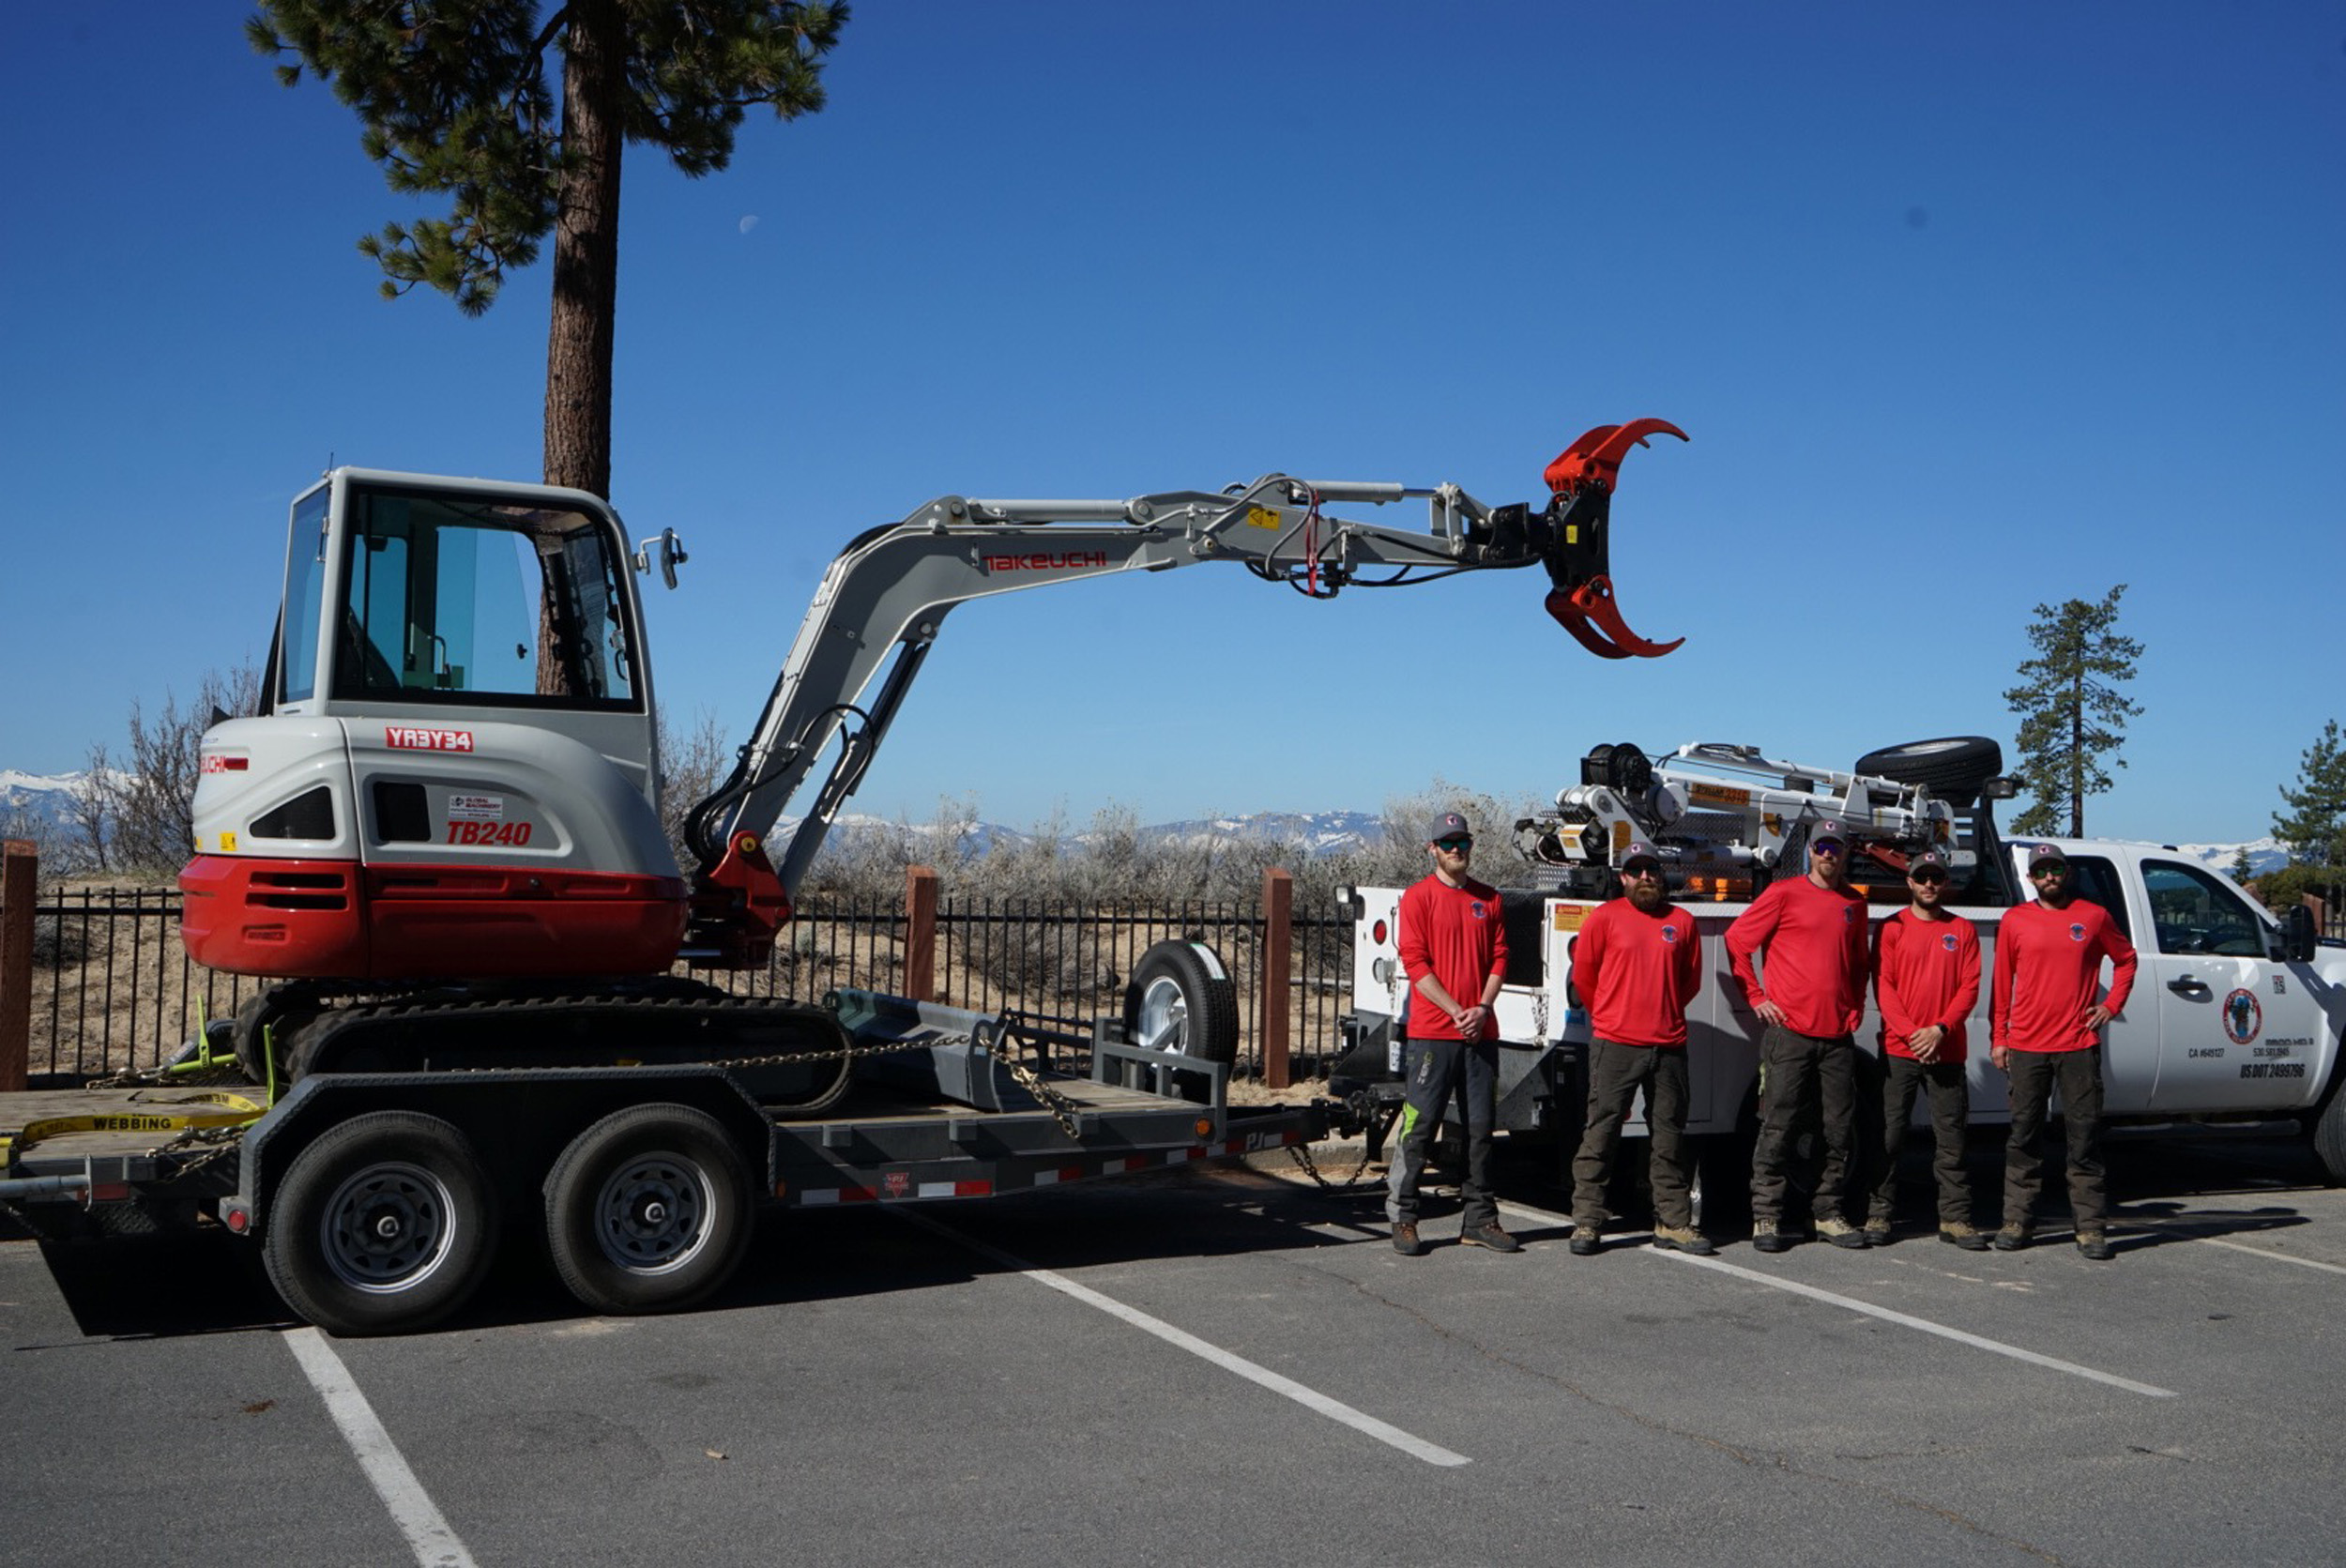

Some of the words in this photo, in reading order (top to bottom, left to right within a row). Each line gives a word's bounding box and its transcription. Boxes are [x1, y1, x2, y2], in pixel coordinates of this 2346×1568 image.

[982, 551, 1106, 571] TAKEUCHI
[447, 821, 532, 846] TB240
[2188, 1047, 2199, 1058] CA
[2240, 1063, 2252, 1079] US
[2252, 1063, 2269, 1078] DOT
[94, 1118, 172, 1130] WEBBING
[1245, 1132, 1265, 1151] PJ
